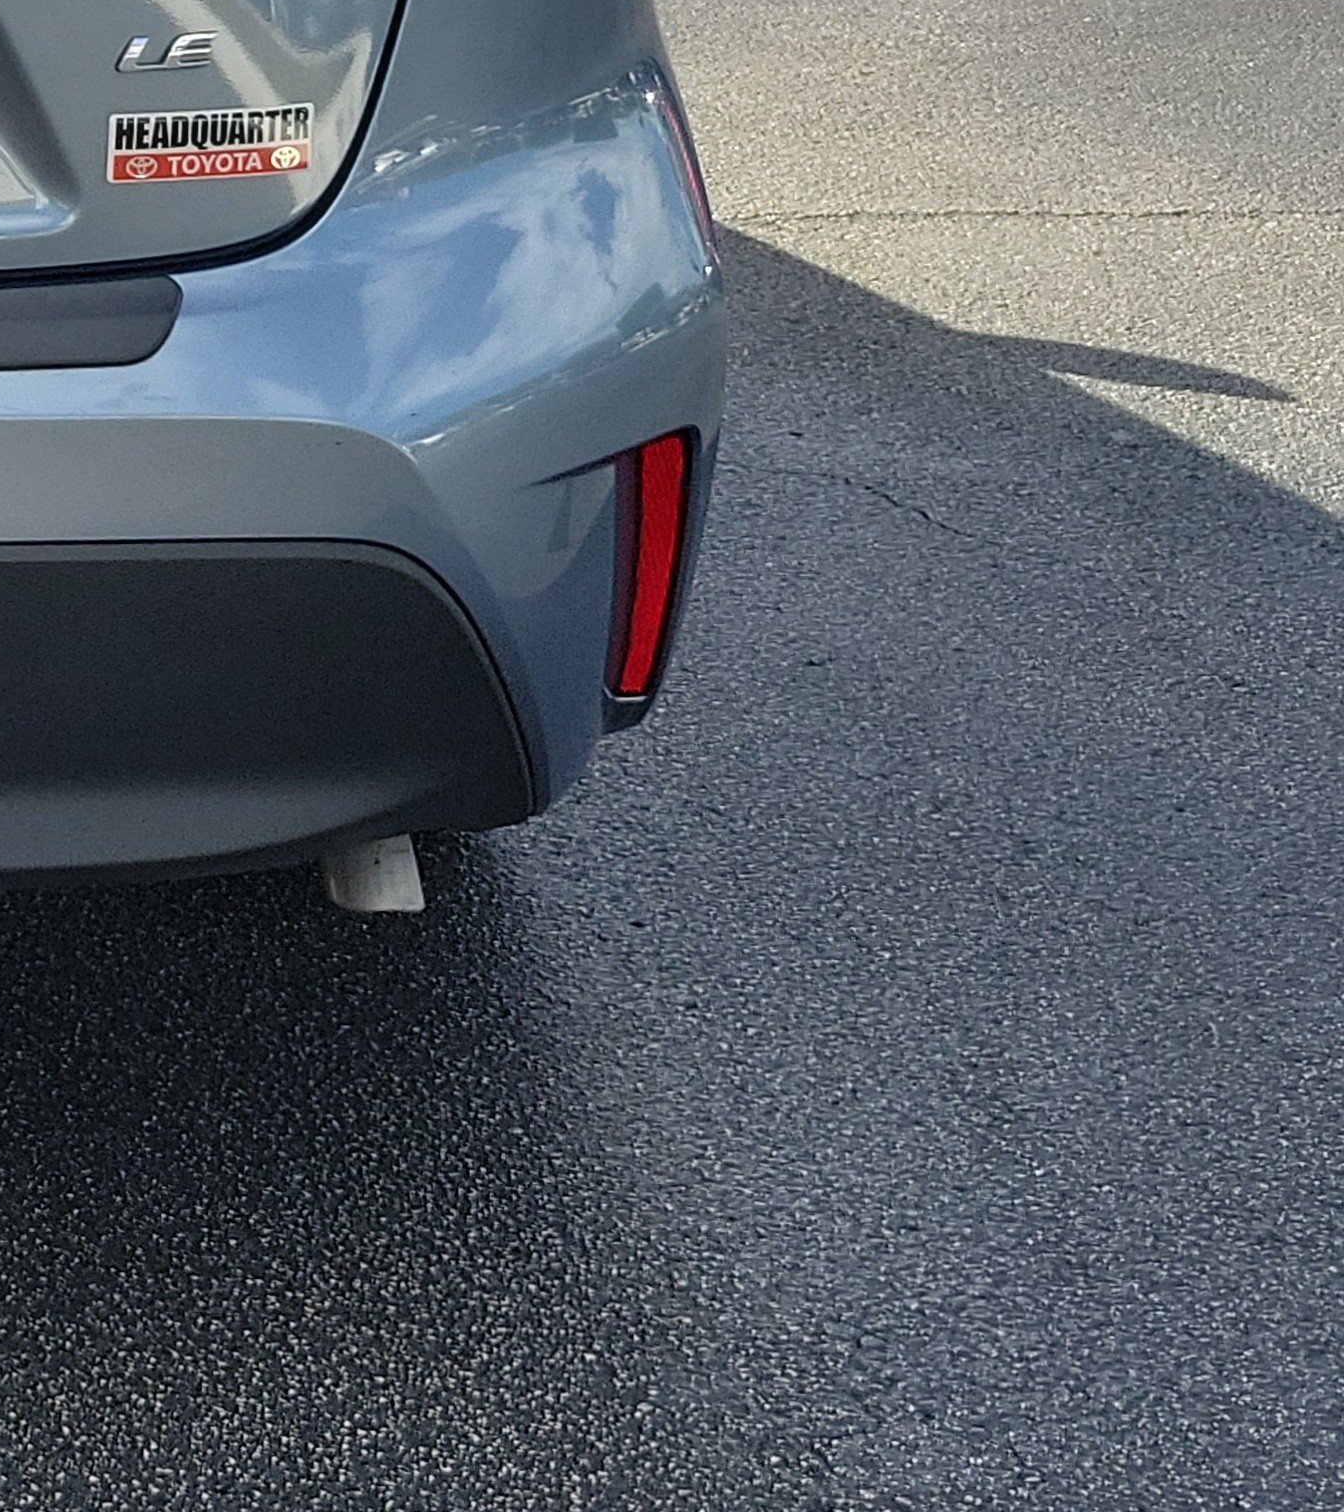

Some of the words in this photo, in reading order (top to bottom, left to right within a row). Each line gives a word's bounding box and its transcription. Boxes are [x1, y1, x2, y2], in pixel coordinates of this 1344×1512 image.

[115, 29, 219, 74] LE
[114, 106, 310, 152] HEADQUARTER
[167, 151, 263, 179] TOYOTA
